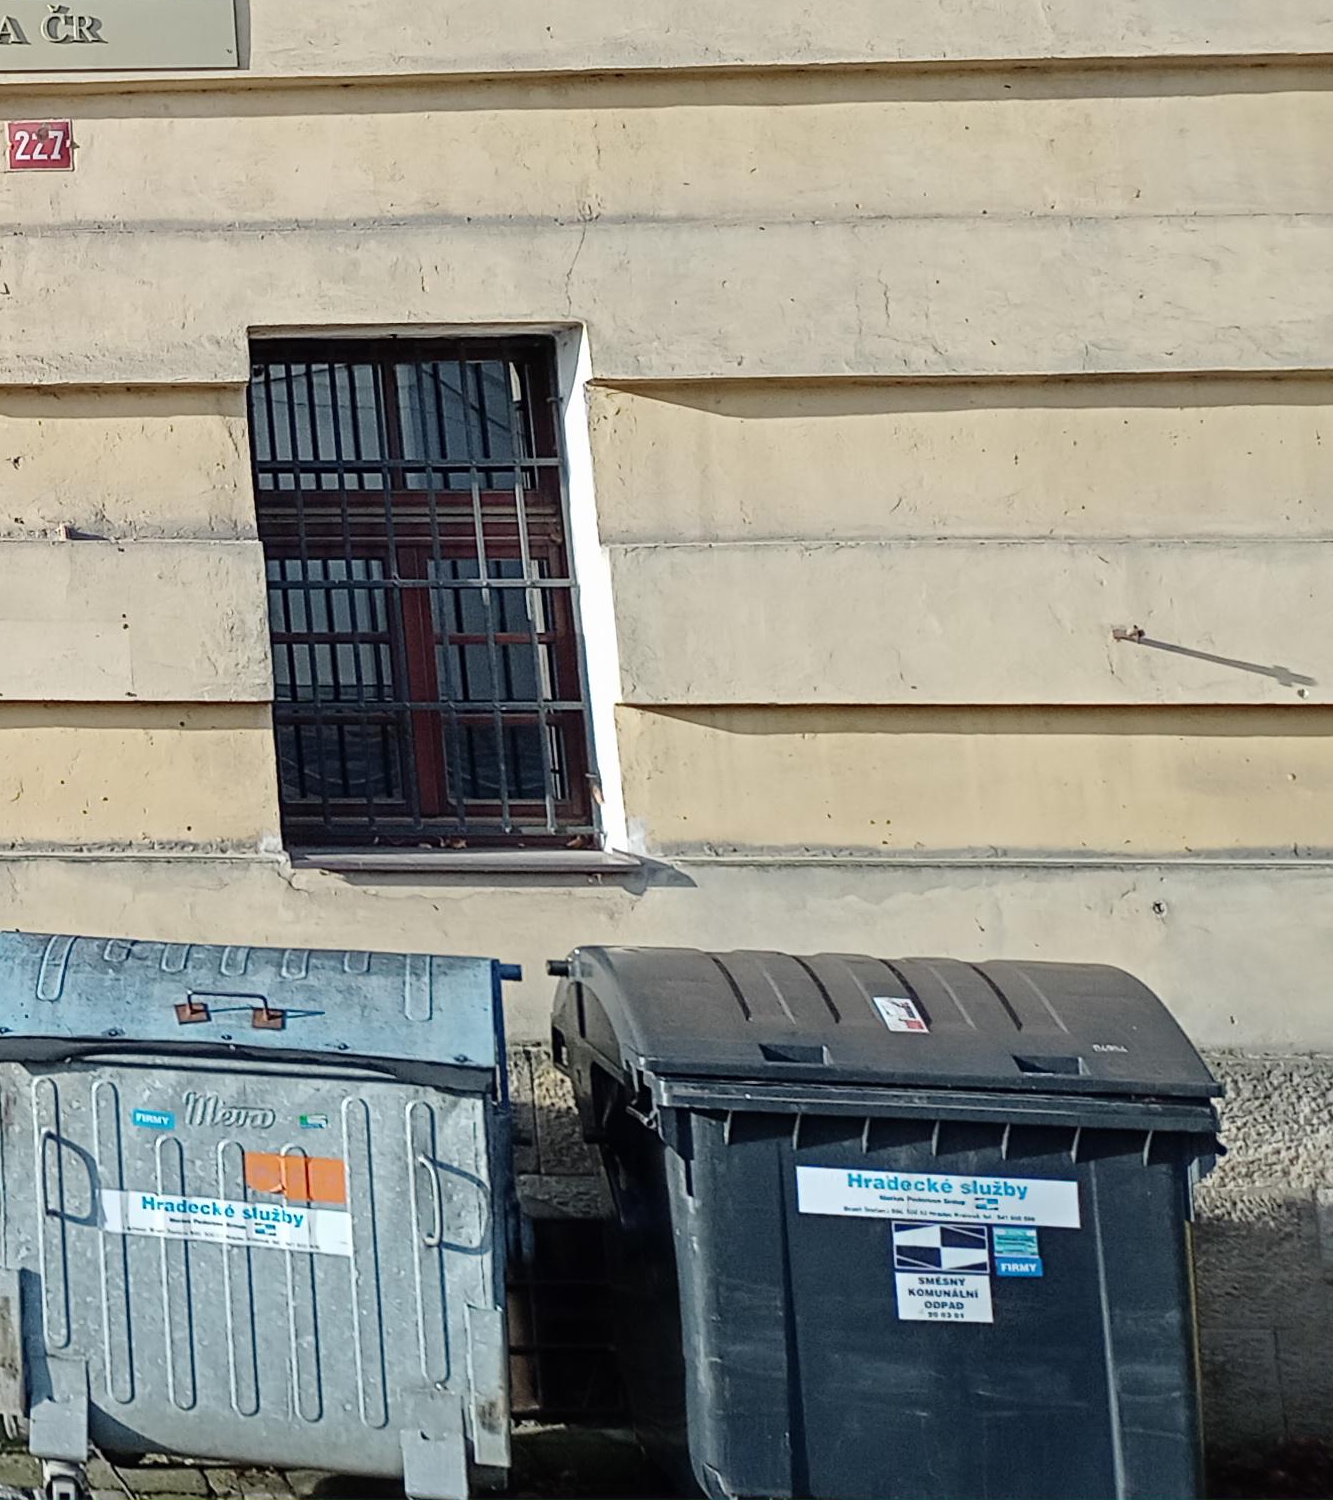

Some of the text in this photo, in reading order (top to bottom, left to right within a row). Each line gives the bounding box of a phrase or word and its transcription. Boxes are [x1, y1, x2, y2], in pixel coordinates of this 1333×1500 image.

[40, 4, 107, 44] ČR
[14, 130, 64, 161] 227
[135, 1112, 170, 1125] FIRMY
[847, 1173, 953, 1194] Hradecké
[960, 1179, 1028, 1200] služby
[141, 1196, 235, 1219] Hradecké
[242, 1204, 304, 1228] služby
[1000, 1262, 1037, 1273] FIRMY
[924, 1301, 965, 1310] ODPAD
